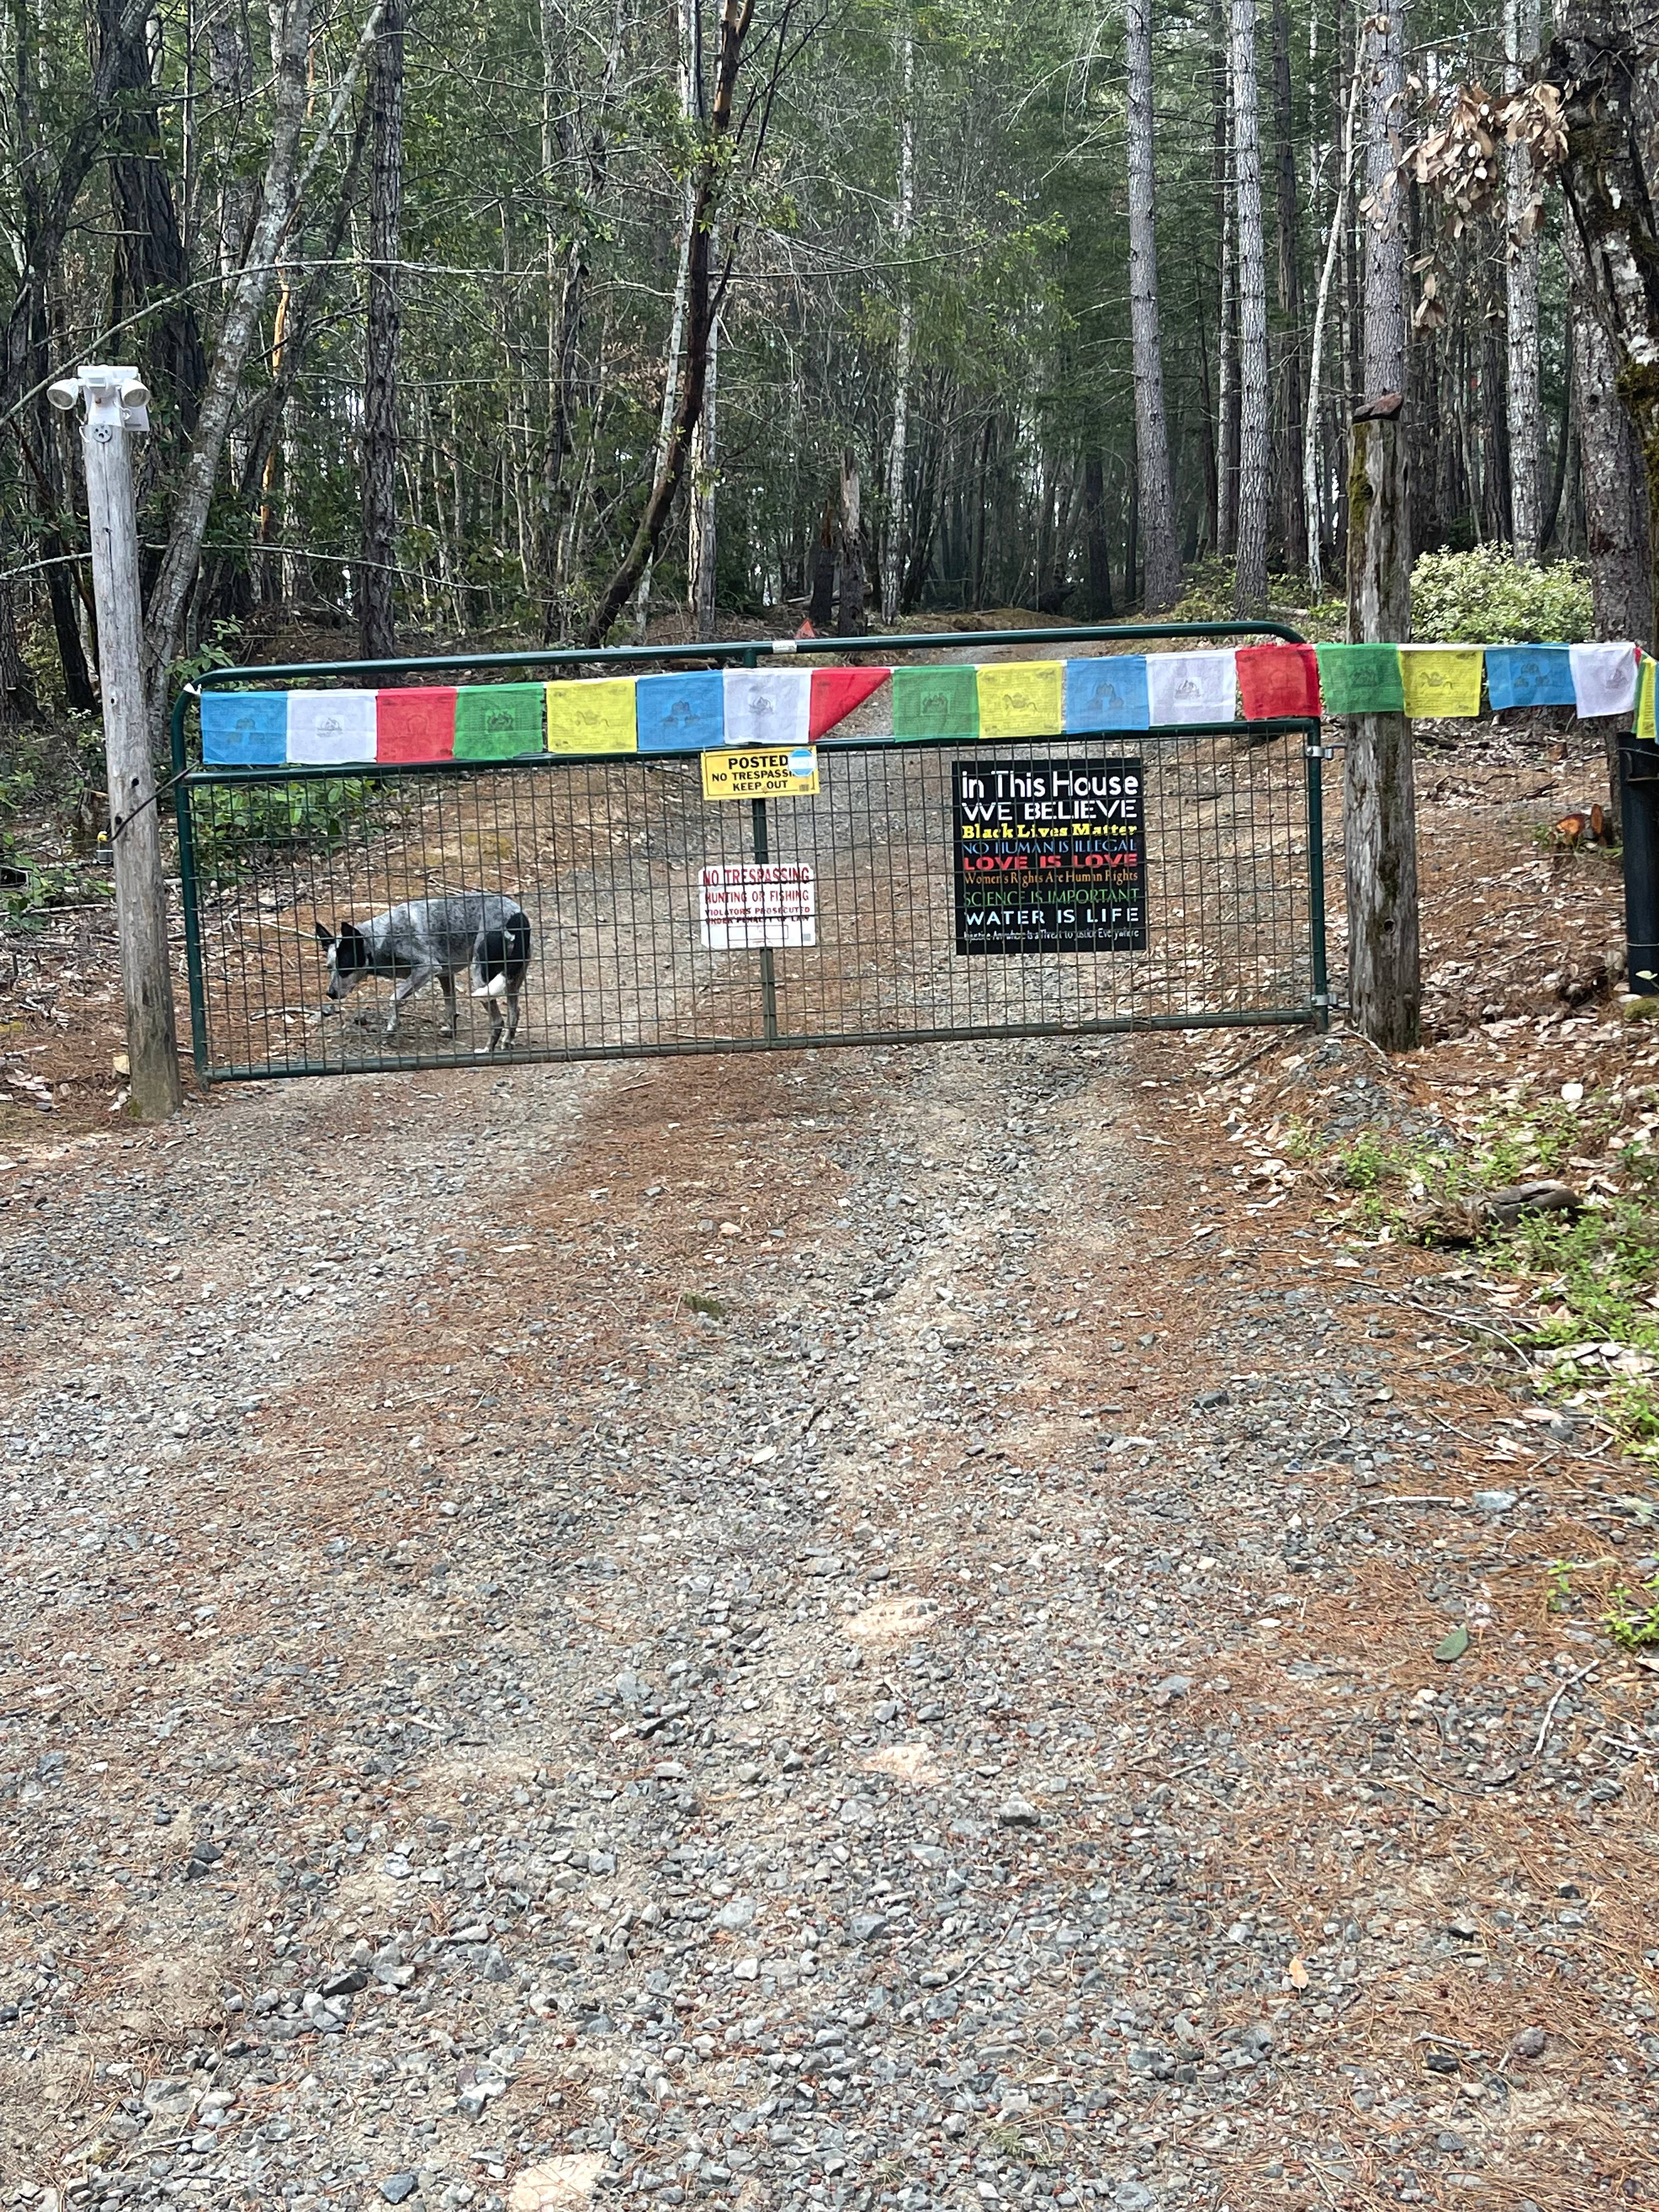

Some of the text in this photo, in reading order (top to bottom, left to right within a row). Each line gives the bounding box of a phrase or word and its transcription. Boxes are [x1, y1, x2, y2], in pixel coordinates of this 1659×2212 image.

[728, 755, 788, 769] POSTED
[712, 769, 795, 781] NO TRESPASSI
[733, 780, 788, 791] KEEP OUT
[991, 770, 1045, 798] This
[1053, 770, 1138, 797] House
[962, 799, 1137, 821] WE BELIEVE
[962, 823, 1137, 838] Black Lives Matter
[962, 839, 1137, 854] NO HUMAN IS ILLEGAL
[963, 853, 1137, 871] LOVE IS LOVE
[703, 867, 809, 886] NO TRESPASSING
[965, 872, 1008, 884] Women's
[1011, 870, 1043, 888] Rghts
[1105, 868, 1138, 885] Rights
[705, 890, 809, 904] HUNTING OR FISHING
[964, 888, 1139, 905] SCIENCE IS IMPORTANT
[705, 907, 751, 916] VIOLATORS
[966, 908, 1138, 925] WATER IS LIFE
[993, 929, 1026, 944] Anwhere
[1074, 928, 1096, 941] ustice
[1098, 927, 1139, 940] Eveywhere
